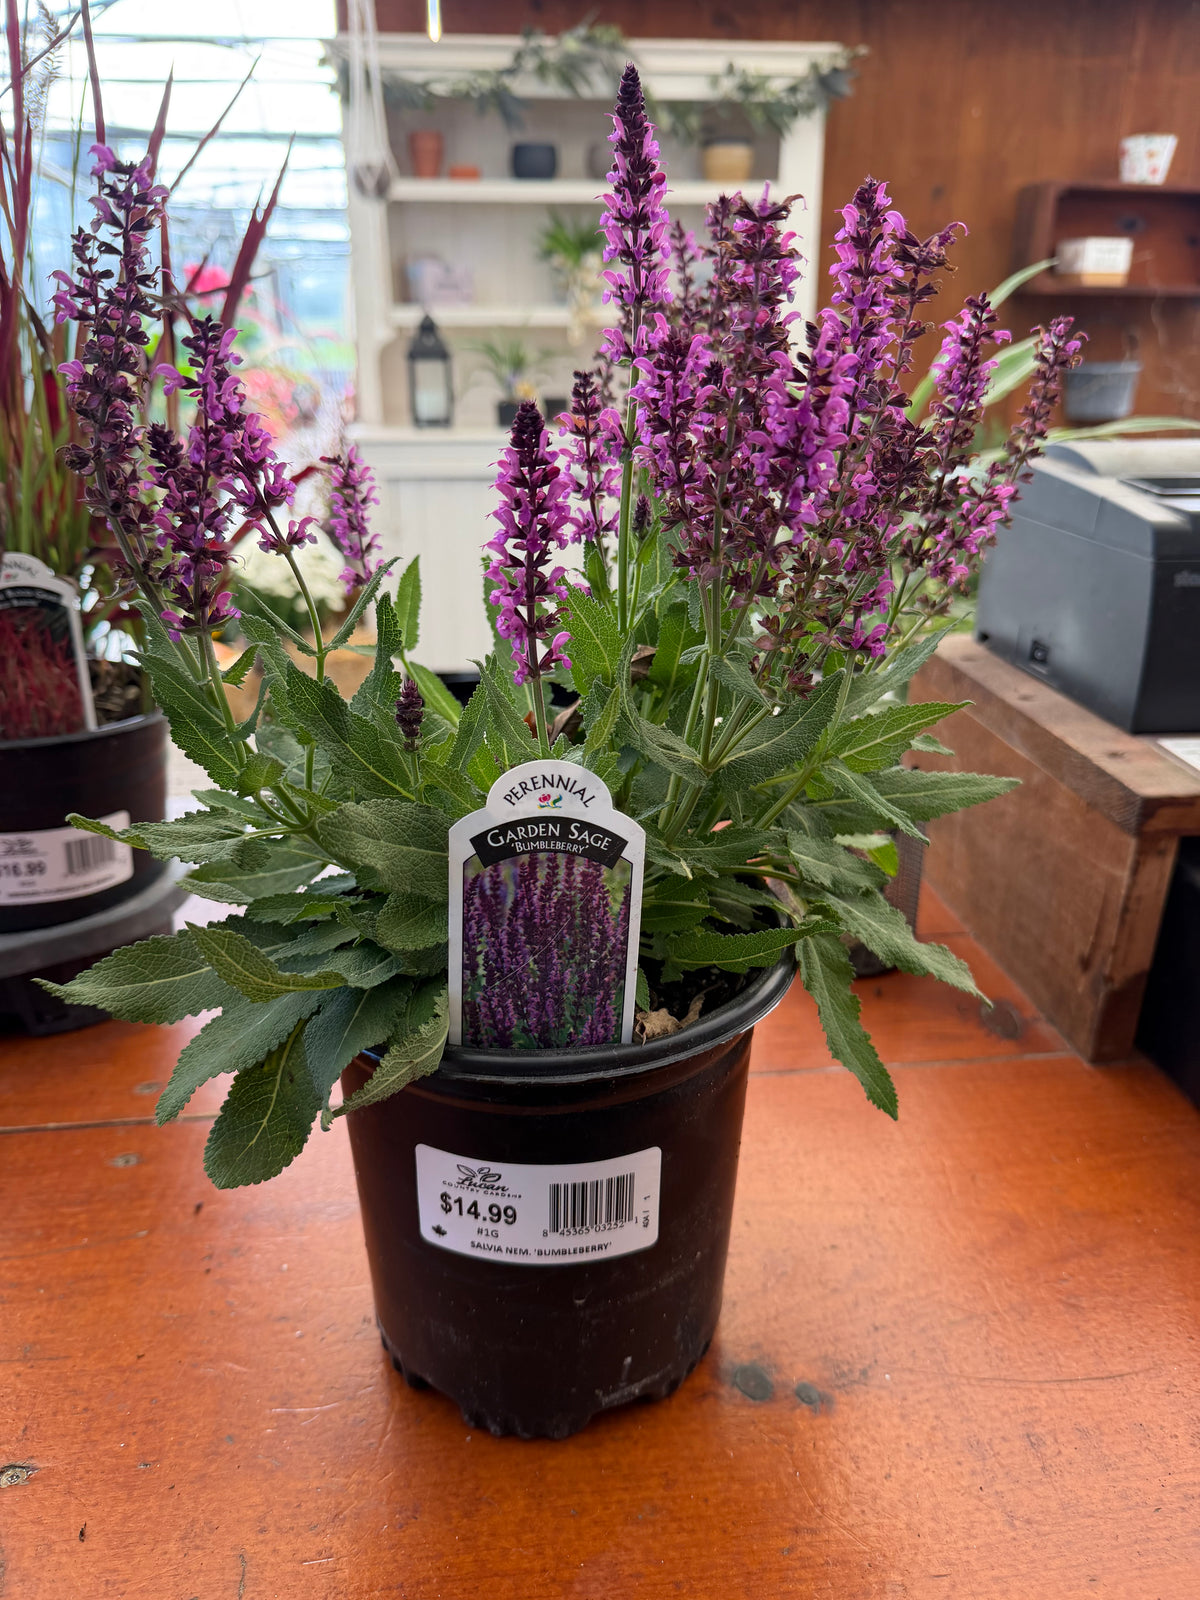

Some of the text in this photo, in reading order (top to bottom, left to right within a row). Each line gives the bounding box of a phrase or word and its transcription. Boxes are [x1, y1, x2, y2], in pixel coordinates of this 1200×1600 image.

[503, 774, 596, 808] PERENNIAL
[487, 822, 612, 851] GARDEN SAGE
[442, 1180, 480, 1193] COUNTRY
[440, 1191, 518, 1225] $14.99
[477, 1227, 499, 1239] #1G
[542, 1215, 639, 1238] 8 45365 03252 1
[470, 1240, 612, 1256] SALVIA NEM. 'BUMBLEBERRY'
